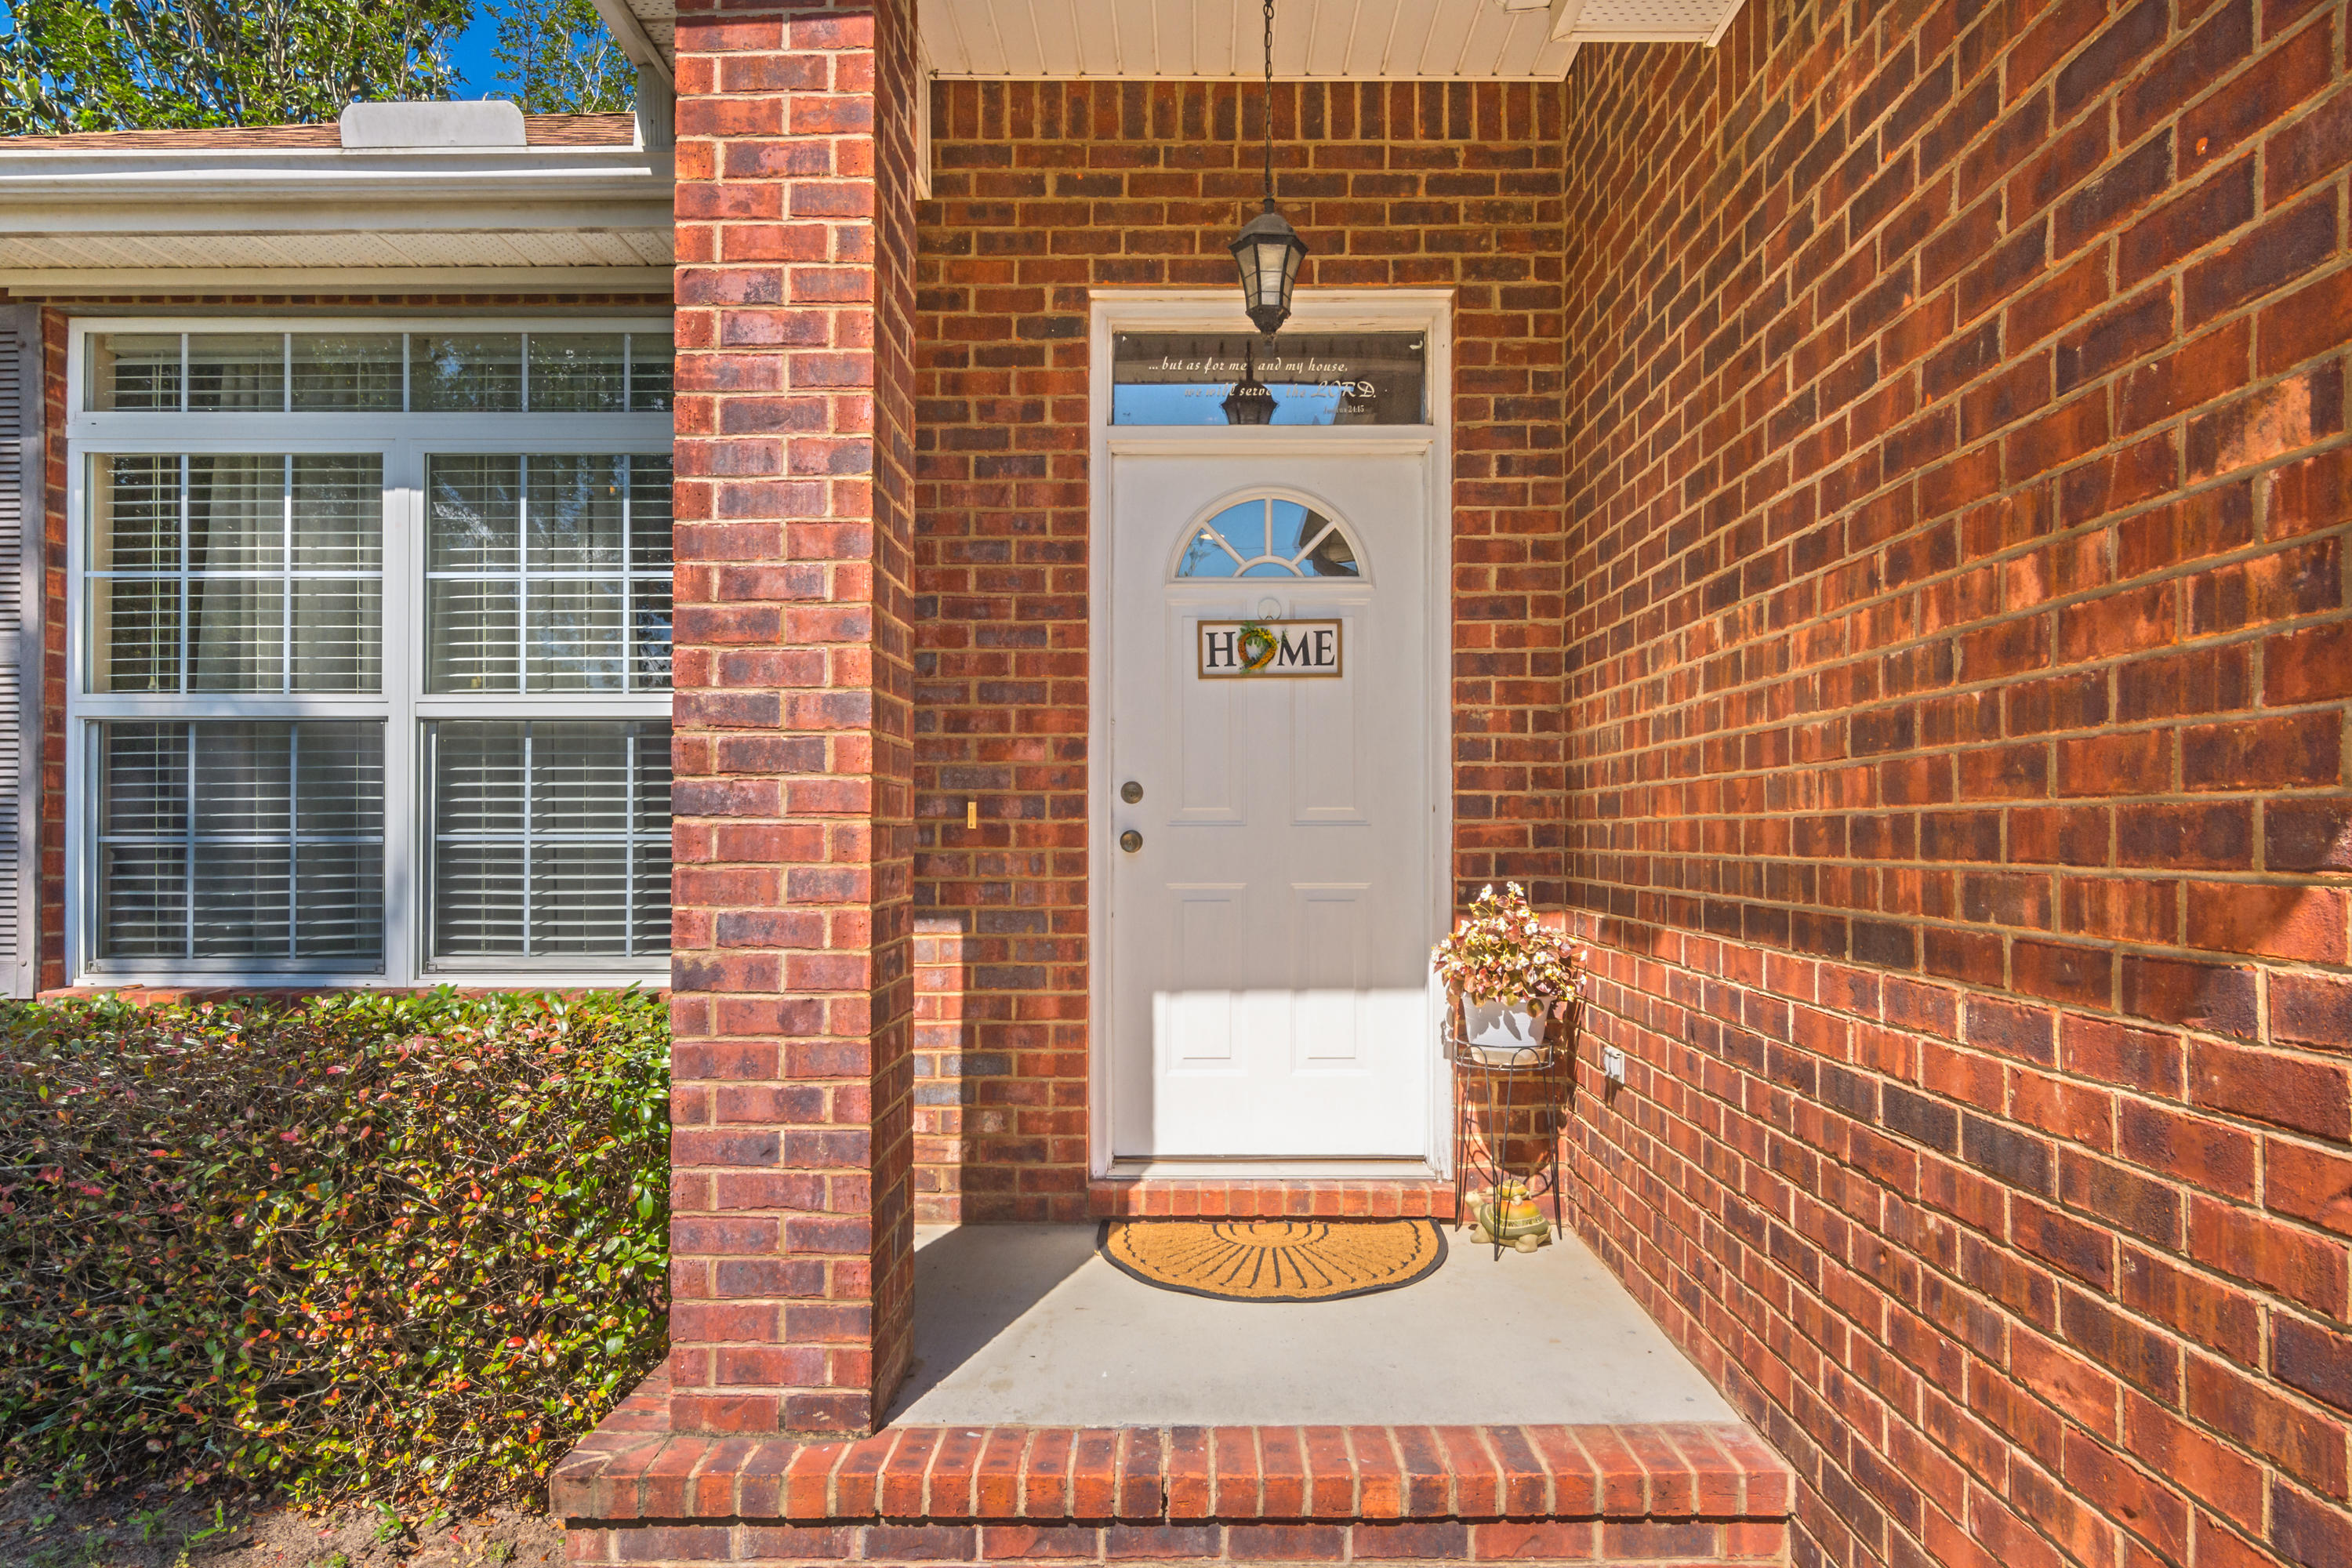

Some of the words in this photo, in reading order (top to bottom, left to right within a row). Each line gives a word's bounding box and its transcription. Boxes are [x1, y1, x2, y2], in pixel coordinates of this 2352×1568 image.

[1186, 361, 1201, 370] as
[1204, 357, 1225, 374] for
[1229, 362, 1247, 371] me
[1258, 357, 1282, 371] and
[1285, 361, 1304, 374] my
[1185, 388, 1202, 397] we
[1206, 382, 1236, 397] will
[1239, 387, 1272, 396] serve
[1286, 383, 1306, 398] the
[1348, 405, 1365, 413] 24:15
[1205, 622, 1335, 671] HOME
